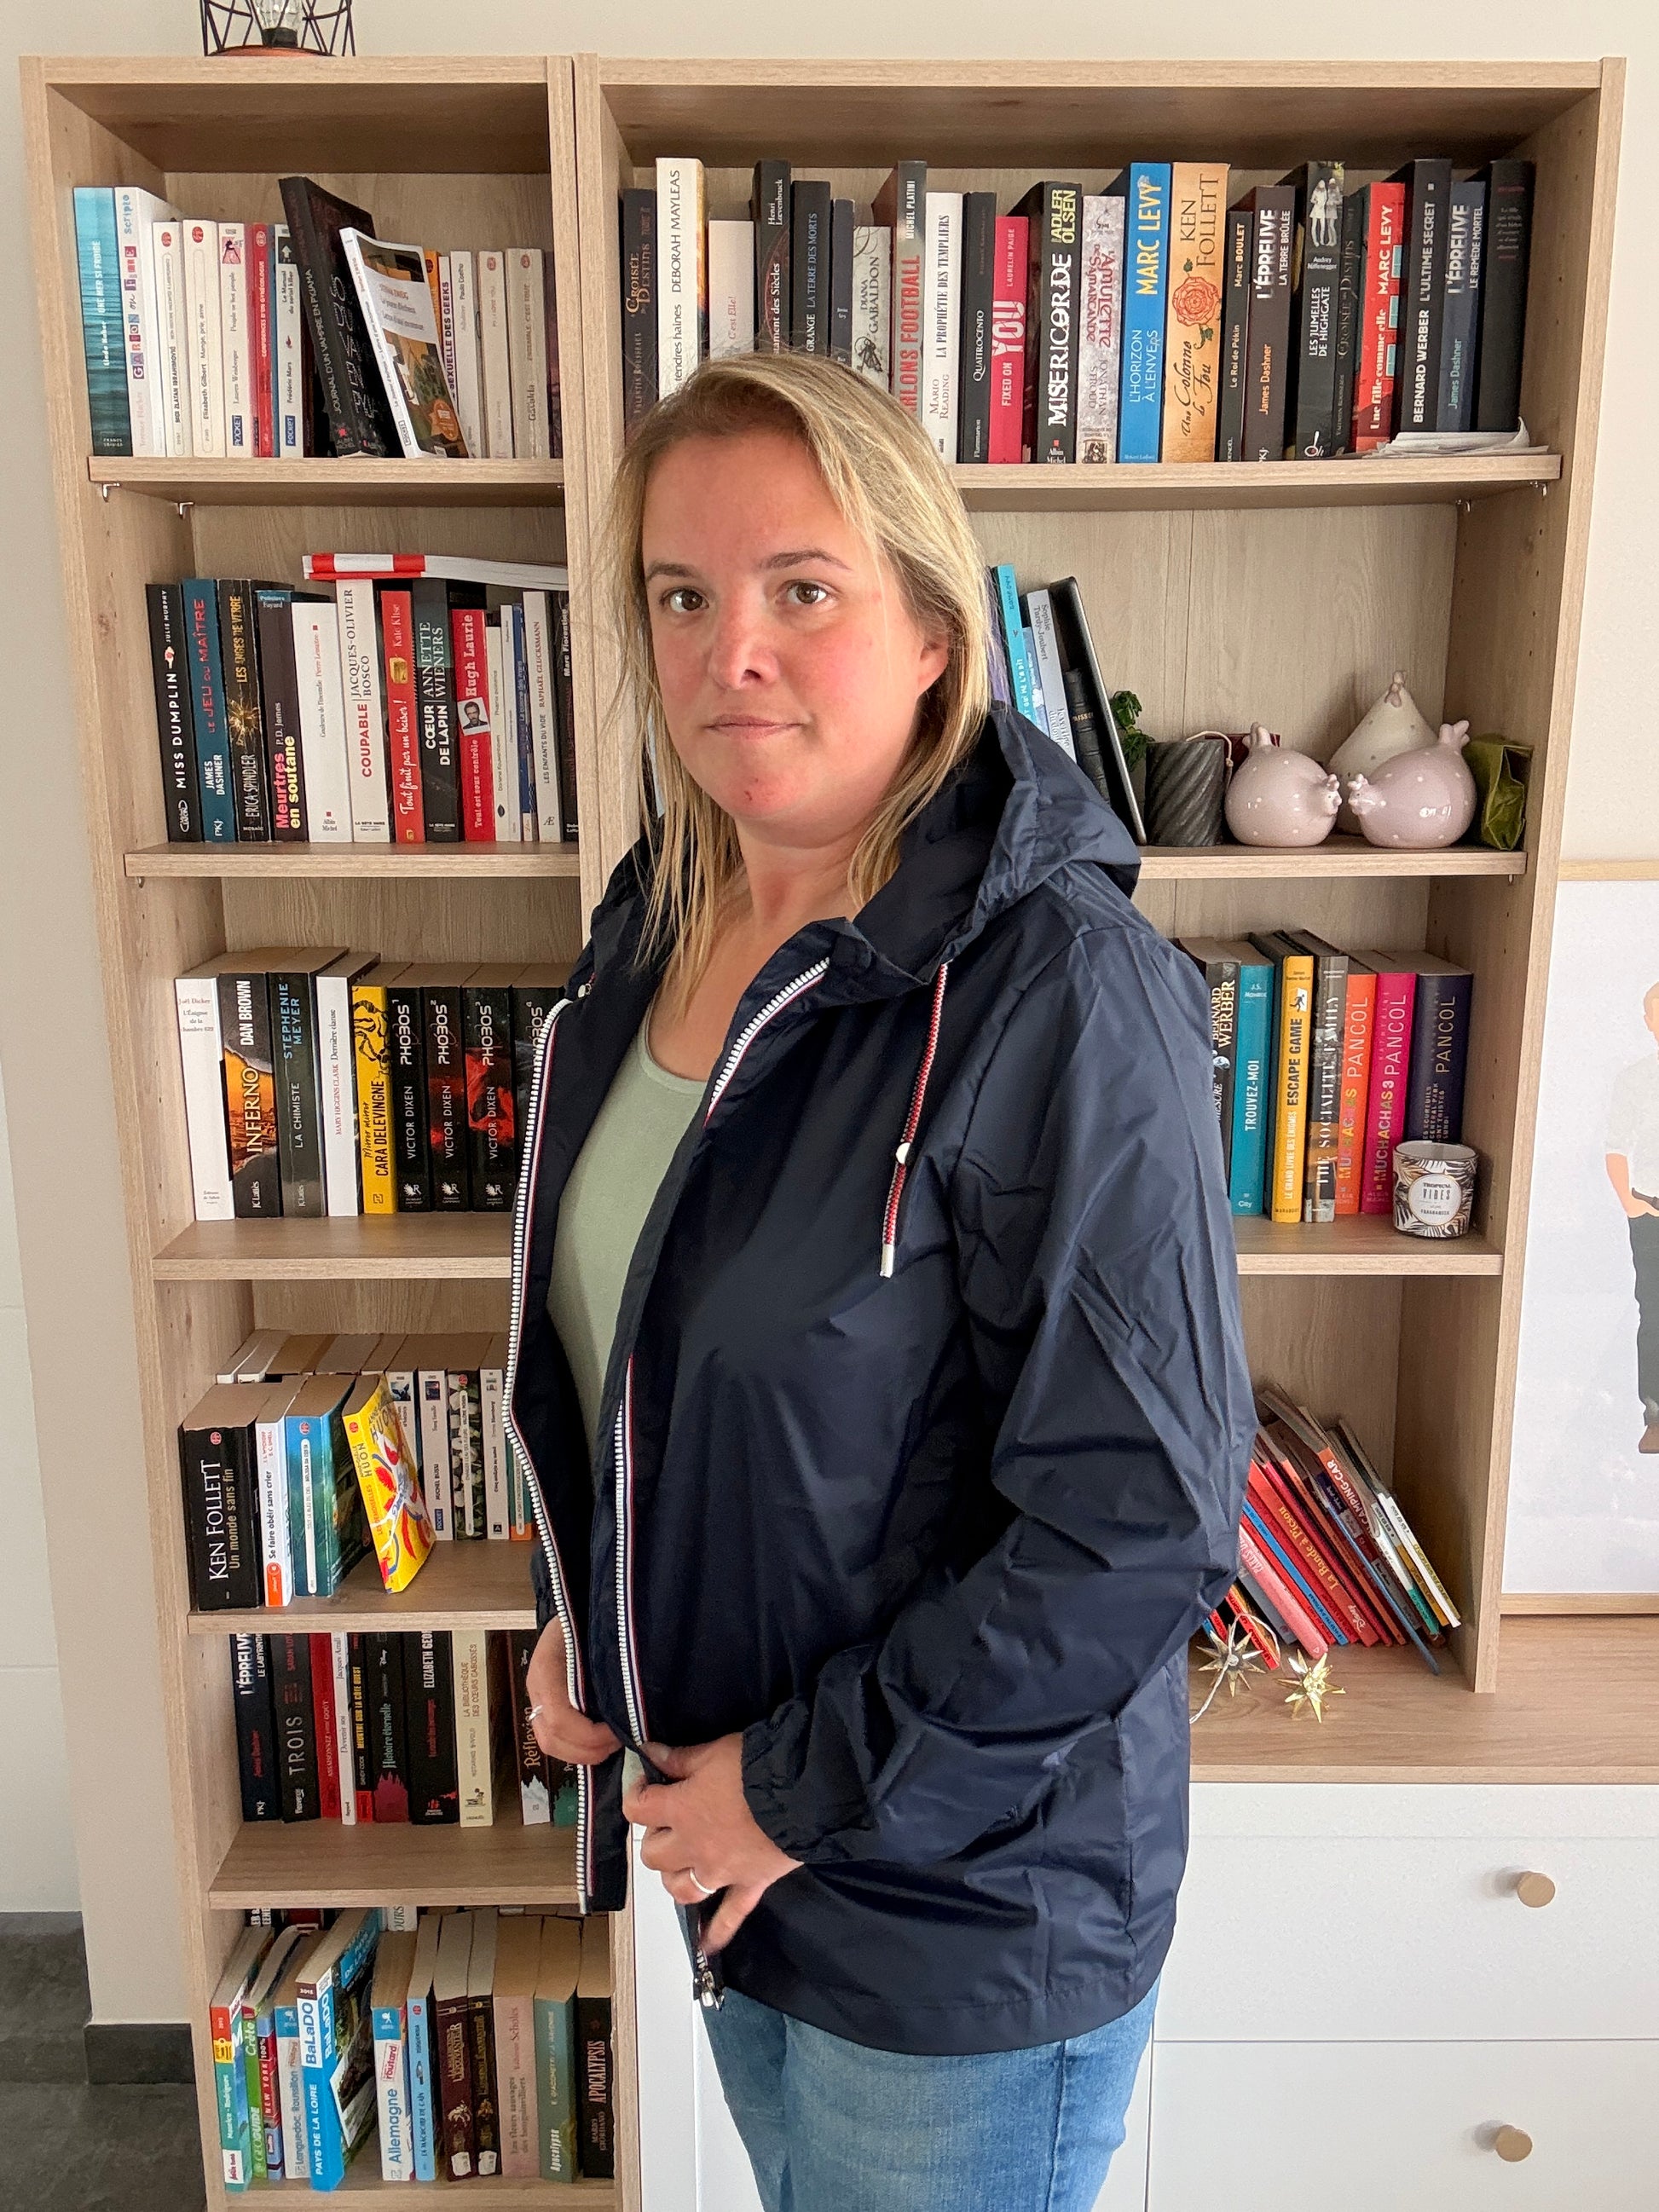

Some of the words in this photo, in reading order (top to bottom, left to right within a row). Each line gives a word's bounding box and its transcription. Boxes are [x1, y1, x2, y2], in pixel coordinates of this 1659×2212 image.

[669, 170, 680, 230] MAYLEAS
[906, 180, 916, 209] PLATINI
[1138, 182, 1161, 230] LEVY
[122, 194, 133, 234] Scripto
[808, 213, 817, 245] MORTS
[905, 211, 916, 239] MICHEL
[1052, 190, 1062, 239] ADLER
[1063, 190, 1076, 243] OLSEN
[1180, 199, 1197, 242] KEN
[1197, 174, 1217, 266] FOLLETT
[1278, 211, 1291, 243] BRÛLÉE
[1379, 205, 1392, 245] LEVY
[1423, 201, 1436, 245] SECRET
[807, 246, 817, 263] DES
[938, 215, 950, 269] TEMPLIERS
[1234, 223, 1245, 262] BOULET
[1253, 210, 1277, 299] L'ÉPREUVE
[1280, 246, 1289, 272] TERRE
[670, 234, 681, 292] DEBORAH
[806, 266, 816, 293] TERRE
[937, 271, 949, 287] DES
[1136, 240, 1159, 294] MARC
[1234, 264, 1243, 286] Marc
[1279, 274, 1288, 285] LA
[1376, 250, 1390, 294] MARC
[1420, 247, 1433, 301] L'ULTIME
[305, 269, 319, 303] PYJAMA
[806, 295, 815, 308] LA
[900, 256, 920, 343] FOOTBALL
[312, 303, 321, 315] EN
[672, 304, 682, 339] haines
[728, 296, 737, 316] Elle!
[934, 290, 948, 343] PROPHÉTIE
[1309, 287, 1321, 338] JUMELLES
[1319, 286, 1331, 341] HIGHGATE
[1375, 309, 1386, 331] elle
[315, 316, 328, 352] VAMPIRE
[443, 318, 452, 337] DES
[973, 310, 986, 381] QUATTROCENTO
[991, 301, 1024, 355] YOU
[1048, 254, 1072, 426] MISERICORDE
[1231, 325, 1240, 349] Pékin
[1417, 310, 1430, 361] WERBER
[323, 353, 332, 373] D'UN
[444, 340, 455, 390] SEXUELLE
[673, 342, 682, 381] tendres
[935, 346, 947, 358] LA
[1145, 330, 1160, 390] L'ENVERS
[1231, 351, 1239, 361] de
[1260, 344, 1272, 383] Dashner
[1309, 339, 1318, 355] LES
[1319, 344, 1327, 356] DE
[1375, 333, 1385, 377] comme
[199, 364, 208, 387] Gilbert
[1003, 362, 1013, 379] ON
[1129, 330, 1142, 402] L'HORIZON
[1230, 362, 1239, 376] Roi
[1230, 378, 1238, 387] Le
[200, 389, 209, 419] Elizabeth
[328, 375, 342, 414] JOURNAL
[929, 378, 939, 414] MARIO
[940, 374, 950, 419] READING
[1003, 382, 1012, 406] FIXED
[1142, 393, 1156, 402] À
[1259, 386, 1270, 414] James
[1370, 378, 1384, 404] fille
[1413, 365, 1425, 423] BERNARD
[233, 415, 241, 445] POCKET
[1370, 407, 1381, 429] Une
[193, 599, 208, 661] MAÎTRE
[343, 590, 361, 697] JACQUES-OLIVIER
[462, 615, 475, 657] Laurie
[360, 656, 372, 696] BOSCO
[419, 622, 434, 697] ANNETTE
[432, 627, 447, 698] WIENERS
[465, 661, 478, 696] Hugh
[166, 673, 182, 745] DUMPLIN
[202, 686, 214, 718] JEU
[208, 723, 216, 732] LE
[357, 704, 373, 777] COUPABLE
[424, 705, 435, 749] CŒUR
[435, 705, 448, 746] LAPIN
[540, 730, 547, 739] DU
[174, 753, 187, 788] MISS
[240, 754, 257, 792] SPINDLER
[284, 736, 299, 803] soutane
[440, 748, 450, 765] DE
[540, 742, 549, 770] ENFANTS
[205, 761, 215, 788] JAMES
[214, 754, 226, 795] DASHNER
[274, 753, 290, 828] Meurtres
[245, 795, 260, 817] ERICA
[291, 808, 301, 829] en
[236, 980, 253, 1019] BROWN
[1218, 979, 1235, 1048] WERBER
[239, 1024, 254, 1045] DAN
[279, 984, 293, 1059] STEPHENIE
[291, 998, 301, 1044] MEYER
[397, 1004, 413, 1065] PHOBOS
[435, 1005, 451, 1064] PHOBOS
[1288, 1019, 1302, 1054] GAME
[1347, 997, 1368, 1077] PANCOL
[1384, 995, 1407, 1076] PANCOL
[1436, 996, 1456, 1073] PANCOL
[1245, 1060, 1259, 1131] TROUVEZ-MOI
[1286, 1059, 1301, 1106] ESCAPE
[242, 1067, 263, 1152] INFERNO
[292, 1083, 302, 1129] CHIMISTE
[371, 1081, 387, 1145] DELEVINGNE
[404, 1086, 414, 1117] DIXEN
[442, 1086, 453, 1116] DIXEN
[294, 1134, 303, 1147] LA
[406, 1122, 416, 1158] VICTOR
[443, 1121, 454, 1158] VICTOR
[373, 1148, 389, 1176] CARA
[222, 1469, 234, 1481] fin
[357, 1442, 373, 1476] HUON
[200, 1459, 225, 1535] FOLLETT
[226, 1486, 236, 1511] sans
[227, 1516, 240, 1551] monde
[265, 1509, 275, 1528] obéir
[1278, 1506, 1302, 1540] Picsou
[267, 1531, 275, 1548] faire
[268, 1550, 276, 1558] Se
[208, 1543, 229, 1580] KEN
[229, 1555, 240, 1569] Un
[1308, 1546, 1332, 1577] Bande
[1326, 1574, 1339, 1590] La
[424, 1651, 435, 1688] ELIZABETH
[286, 1716, 306, 1776] TROIS
[383, 1736, 397, 1768] Histoire
[245, 2022, 257, 2056] Crète
[257, 2038, 268, 2059] 100%
[302, 2001, 317, 2065] BaLaDO
[261, 2063, 270, 2088] YORK
[587, 2040, 606, 2103] APOCALYPSIS
[263, 2092, 272, 2114] NEW
[309, 2084, 319, 2114] LOIRE
[310, 2117, 320, 2129] LA
[312, 2133, 321, 2146] DE
[386, 2089, 402, 2163] Allemagne
[312, 2149, 323, 2175] PAYS
